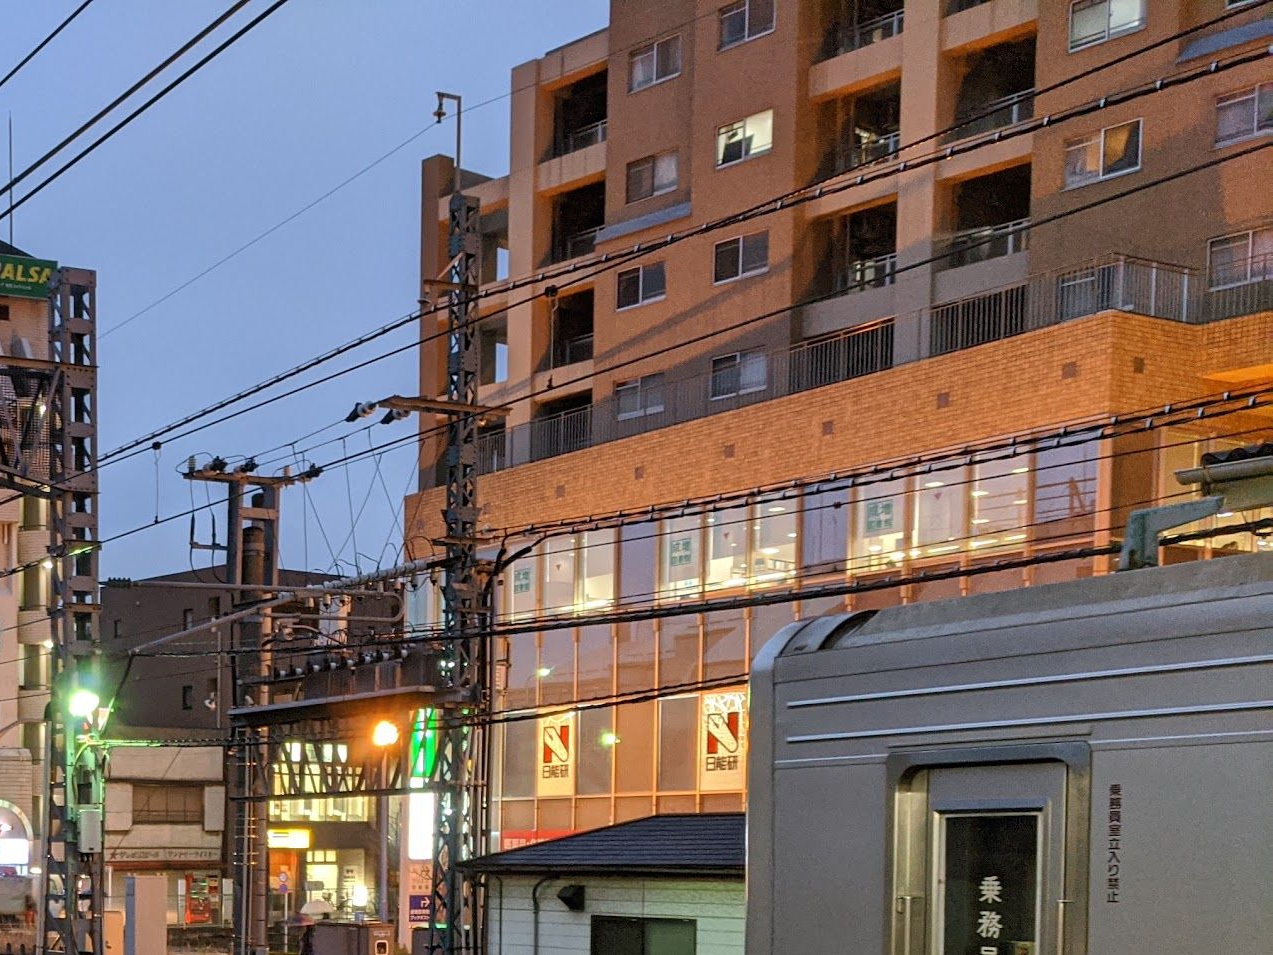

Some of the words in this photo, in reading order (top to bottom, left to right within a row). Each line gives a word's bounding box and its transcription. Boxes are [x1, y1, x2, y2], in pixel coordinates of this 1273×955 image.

[542, 764, 569, 779] 日能研
[706, 755, 739, 772] 日能研
[1107, 783, 1122, 904] 乗務員室立入り禁止
